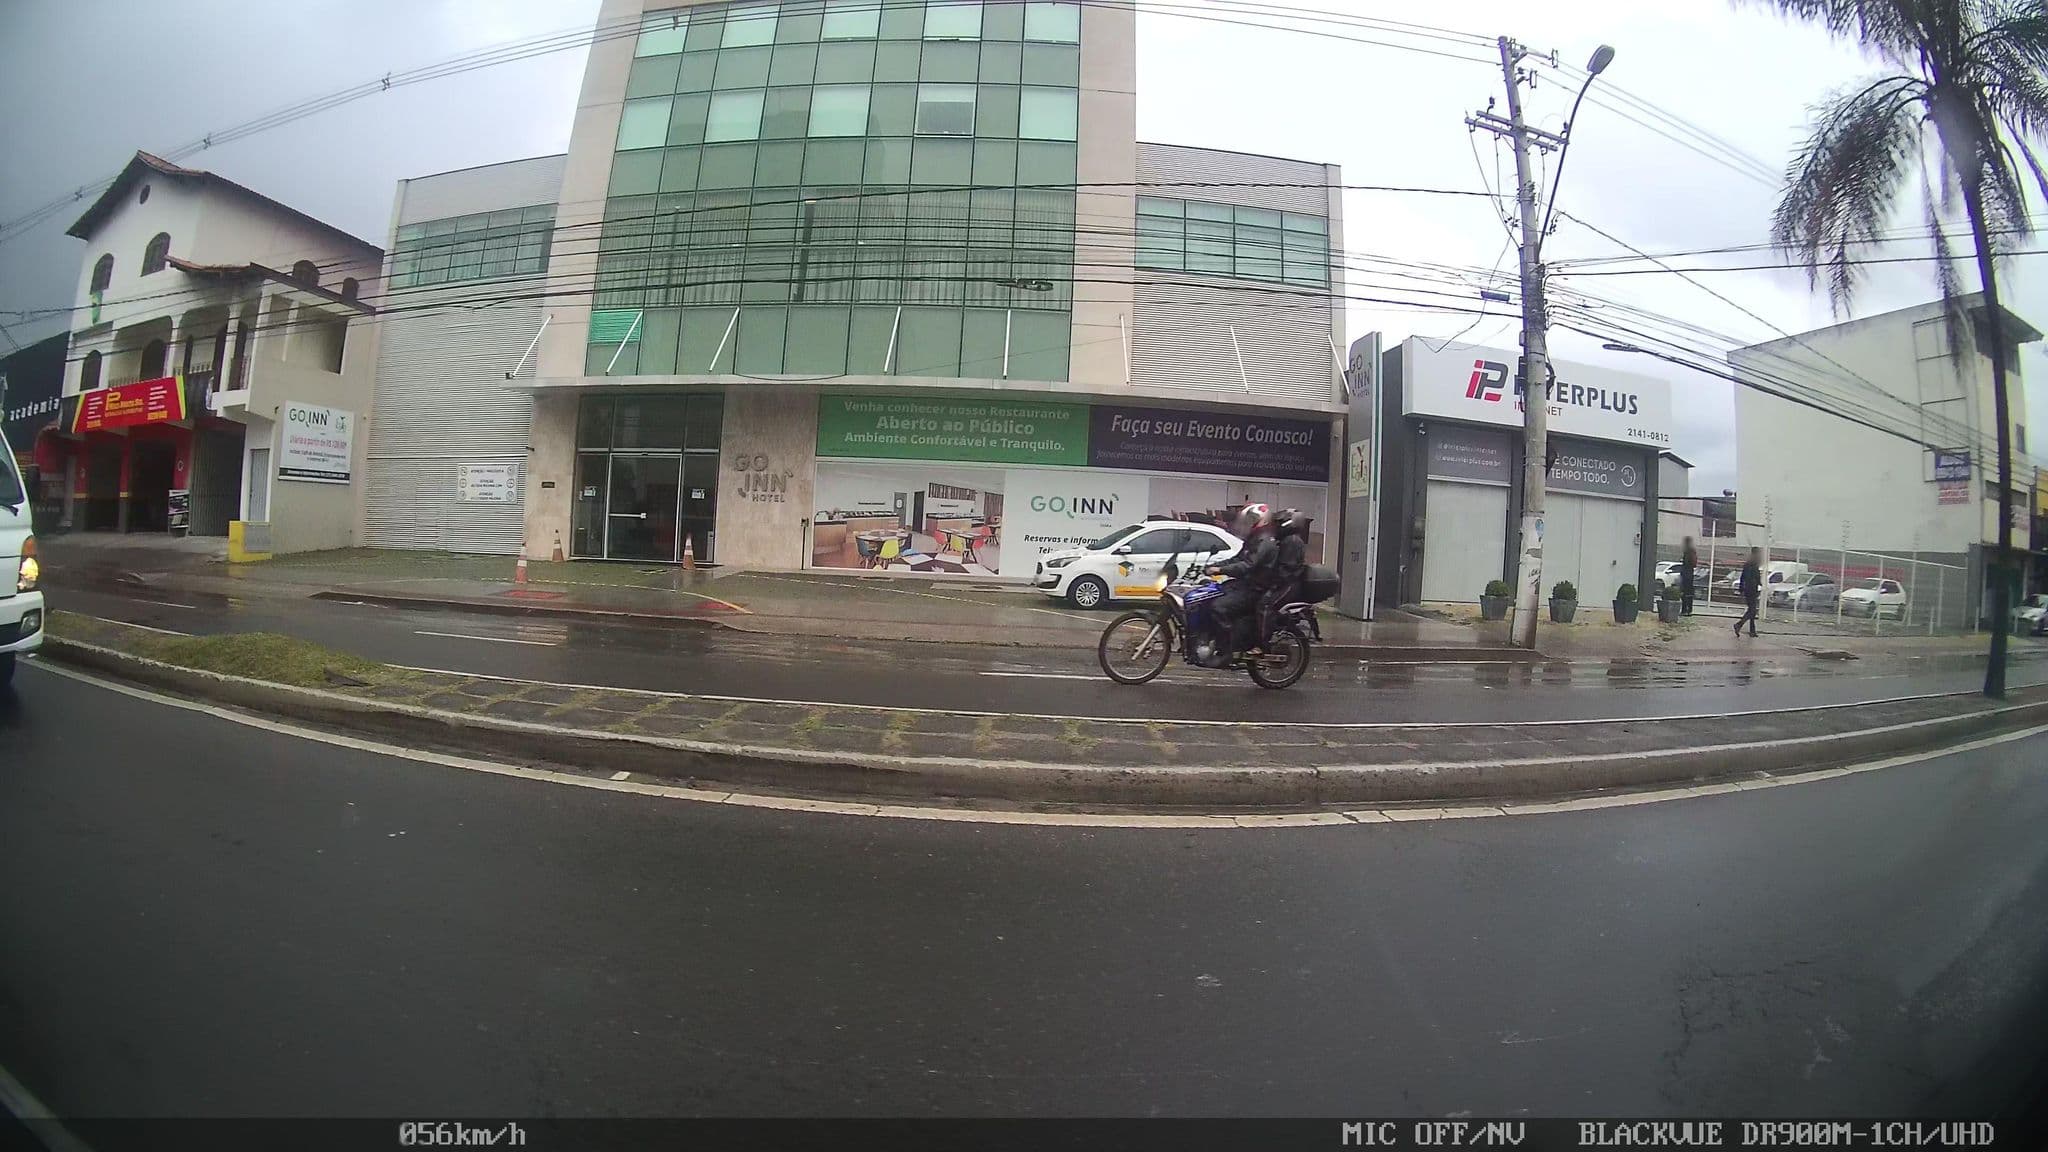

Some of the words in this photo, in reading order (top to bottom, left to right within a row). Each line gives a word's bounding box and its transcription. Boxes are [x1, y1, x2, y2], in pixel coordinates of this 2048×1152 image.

[289, 408, 306, 422] GO
[308, 411, 328, 426] INN
[843, 401, 884, 412] Venha
[887, 402, 945, 415] conhecer
[949, 406, 986, 416] nosso
[990, 406, 1070, 420] Restaurante
[876, 416, 938, 431] Aberto
[943, 420, 964, 432] ao
[969, 419, 1035, 435] Público
[1111, 414, 1151, 438] Faça
[1154, 420, 1183, 436] seu
[1187, 420, 1240, 440] Evento
[1245, 424, 1314, 445] Conosco!
[844, 432, 907, 444] Ambiente
[910, 434, 986, 448] Confortável
[989, 438, 997, 447] e
[1001, 438, 1065, 451] Tranquilo.
[1627, 427, 1670, 443] 2141-0812
[734, 455, 769, 472] GO
[1562, 456, 1616, 471] CONECTADO
[744, 473, 787, 493] INN
[1551, 468, 1581, 481] TEMPO
[1583, 471, 1610, 485] TODO.
[752, 494, 786, 503] HOTEL
[1030, 495, 1066, 512] GO
[1072, 497, 1114, 514] INN
[1024, 534, 1061, 543] Reservas
